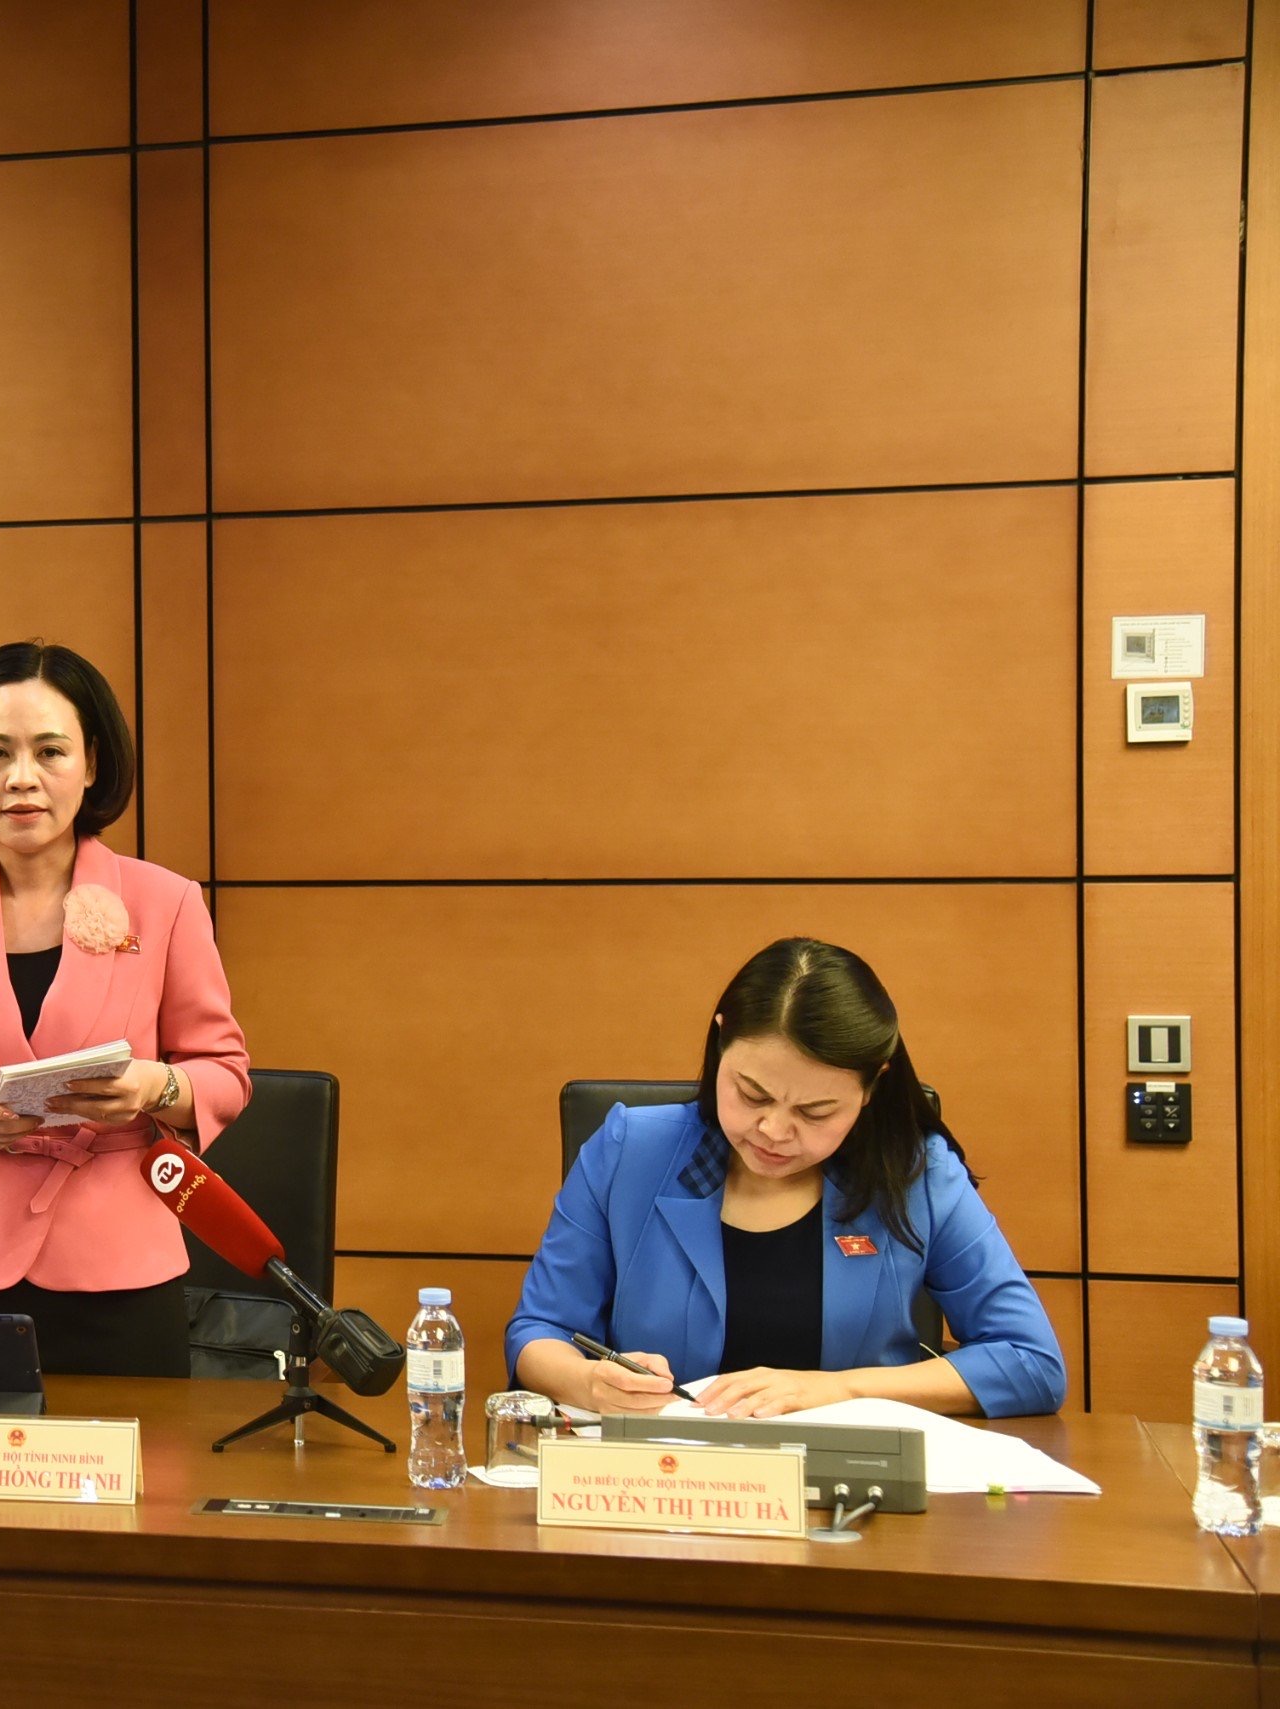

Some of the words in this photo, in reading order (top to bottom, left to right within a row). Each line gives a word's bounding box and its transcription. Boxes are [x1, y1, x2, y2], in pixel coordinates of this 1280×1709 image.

[177, 1187, 193, 1213] QUỐC
[191, 1174, 207, 1189] HỘI
[2, 1451, 21, 1464] HỘI
[24, 1450, 49, 1463] TỈNH
[51, 1453, 76, 1464] NINH
[79, 1452, 104, 1465] BÌNH
[573, 1474, 591, 1487] ĐẠI
[595, 1474, 620, 1486] BIỂU
[622, 1476, 653, 1489] QUỐC
[657, 1478, 676, 1490] HỘI
[679, 1478, 706, 1490] TỈNH
[708, 1480, 736, 1491] NINH
[739, 1480, 766, 1493] BÌNH
[552, 1490, 647, 1513] NGUYỄN
[653, 1496, 693, 1520] THỊ
[700, 1499, 748, 1518] THU
[756, 1498, 789, 1520] HÀ
